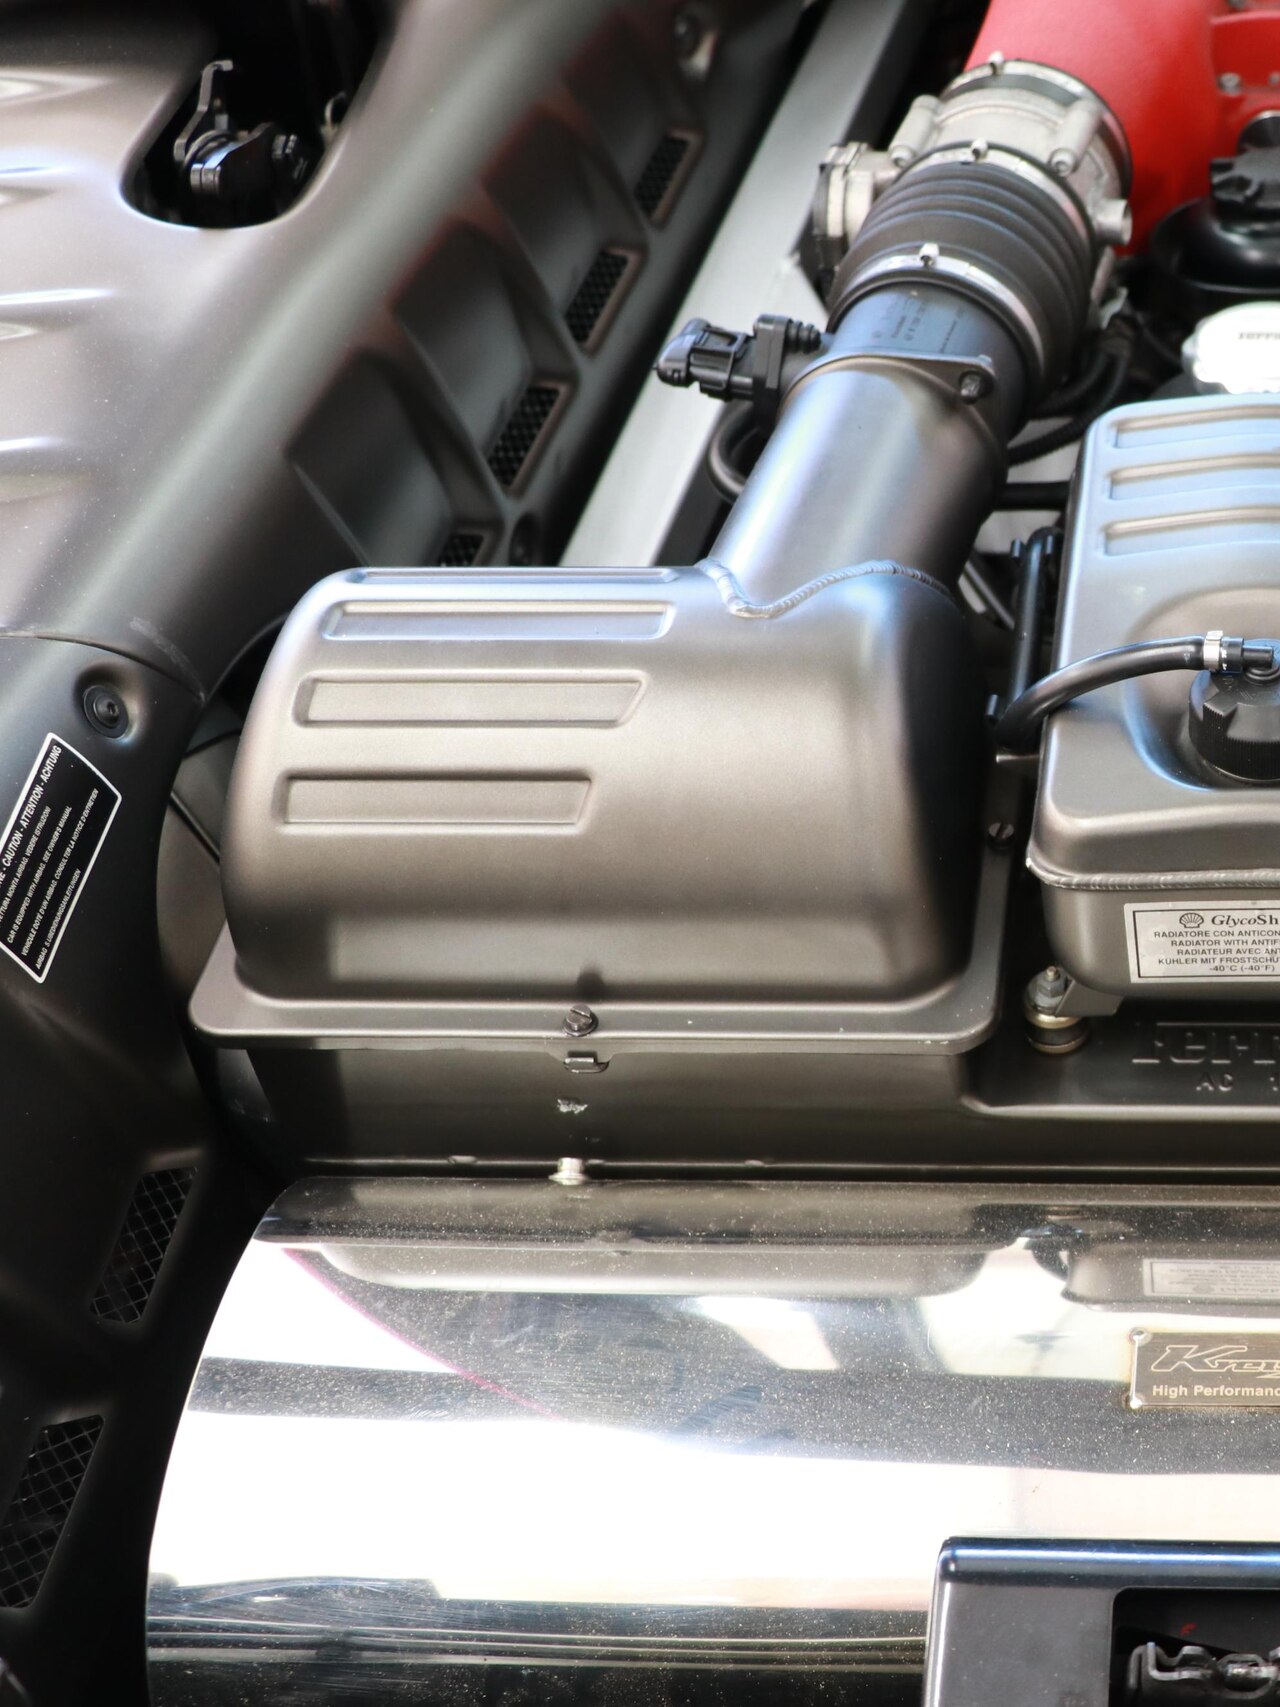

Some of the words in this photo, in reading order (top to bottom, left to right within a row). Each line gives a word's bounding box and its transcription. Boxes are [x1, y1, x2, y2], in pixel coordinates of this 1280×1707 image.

[2, 830, 23, 867] CAUTION
[20, 785, 44, 829] ATTENTION
[41, 746, 62, 782] ACHTUNG
[6, 876, 19, 898] MONTA
[15, 854, 29, 878] AIRBAG.
[24, 834, 38, 857] VEDERE
[33, 805, 51, 836] ISTRUZIONI
[6, 928, 16, 944] CAR
[14, 895, 31, 925] EQUIPPED
[26, 881, 37, 898] WITH
[32, 860, 46, 884] AIRBAG.
[42, 849, 51, 863] SEE
[47, 825, 62, 852] OWNER'S
[58, 805, 72, 828] MANUAL
[20, 927, 37, 957] VEHICULE
[38, 898, 48, 914] D'UN
[53, 846, 72, 880] CONSULTER
[67, 838, 75, 849] LA
[71, 819, 84, 841] NOTICE
[80, 788, 99, 821] D'ENTRETIEN
[34, 946, 48, 969] AIRBAG
[1158, 957, 1198, 965] KÜHLER
[1201, 957, 1217, 965] MIT
[1177, 948, 1233, 956] RADIATEUR
[1195, 1071, 1233, 1092] AC
[1152, 1385, 1188, 1399] High
